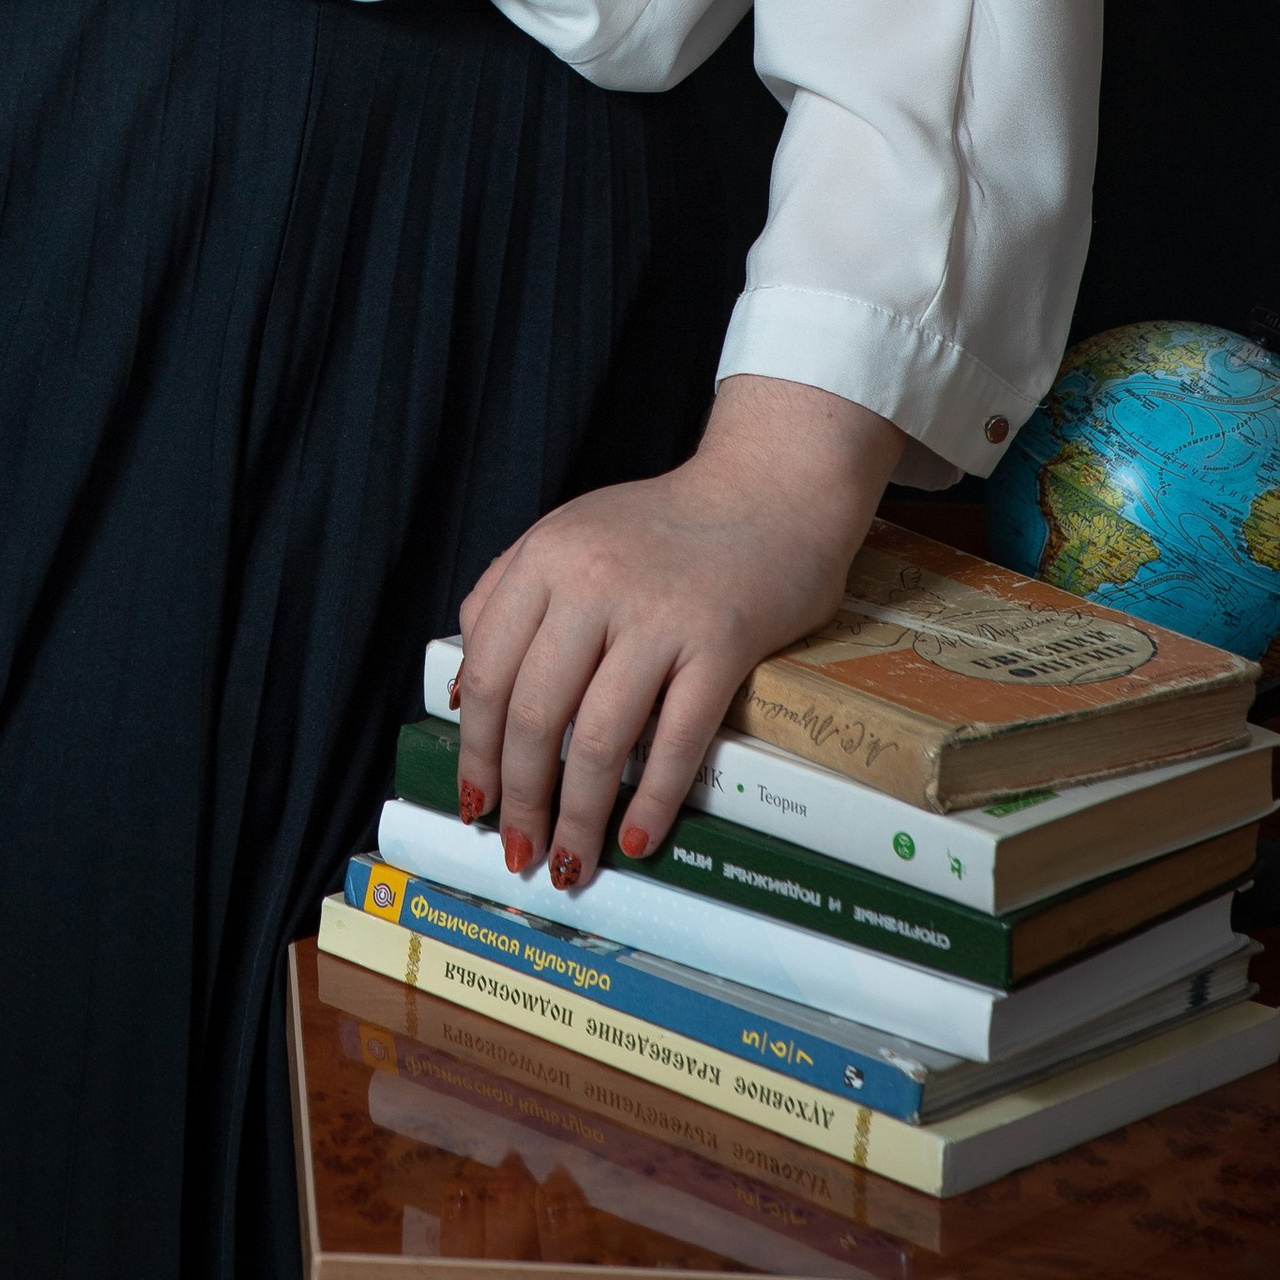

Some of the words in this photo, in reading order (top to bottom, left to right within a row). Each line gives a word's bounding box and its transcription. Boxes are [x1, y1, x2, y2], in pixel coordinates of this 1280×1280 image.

[757, 783, 808, 818] Теория
[673, 844, 713, 872] ИГРЫ
[722, 861, 823, 907] ПОДВИЖНЫЕ
[828, 895, 842, 913] И
[410, 894, 520, 955] Физическая
[523, 942, 611, 992] культура
[853, 904, 951, 951] СПОРТИВНЫЕ
[443, 960, 575, 1028] ПОДМОСКОВЬЯ
[585, 1016, 722, 1087] КРАЕВЕДЕНИЕ
[733, 1075, 836, 1130] ДУХОВНОЕ
